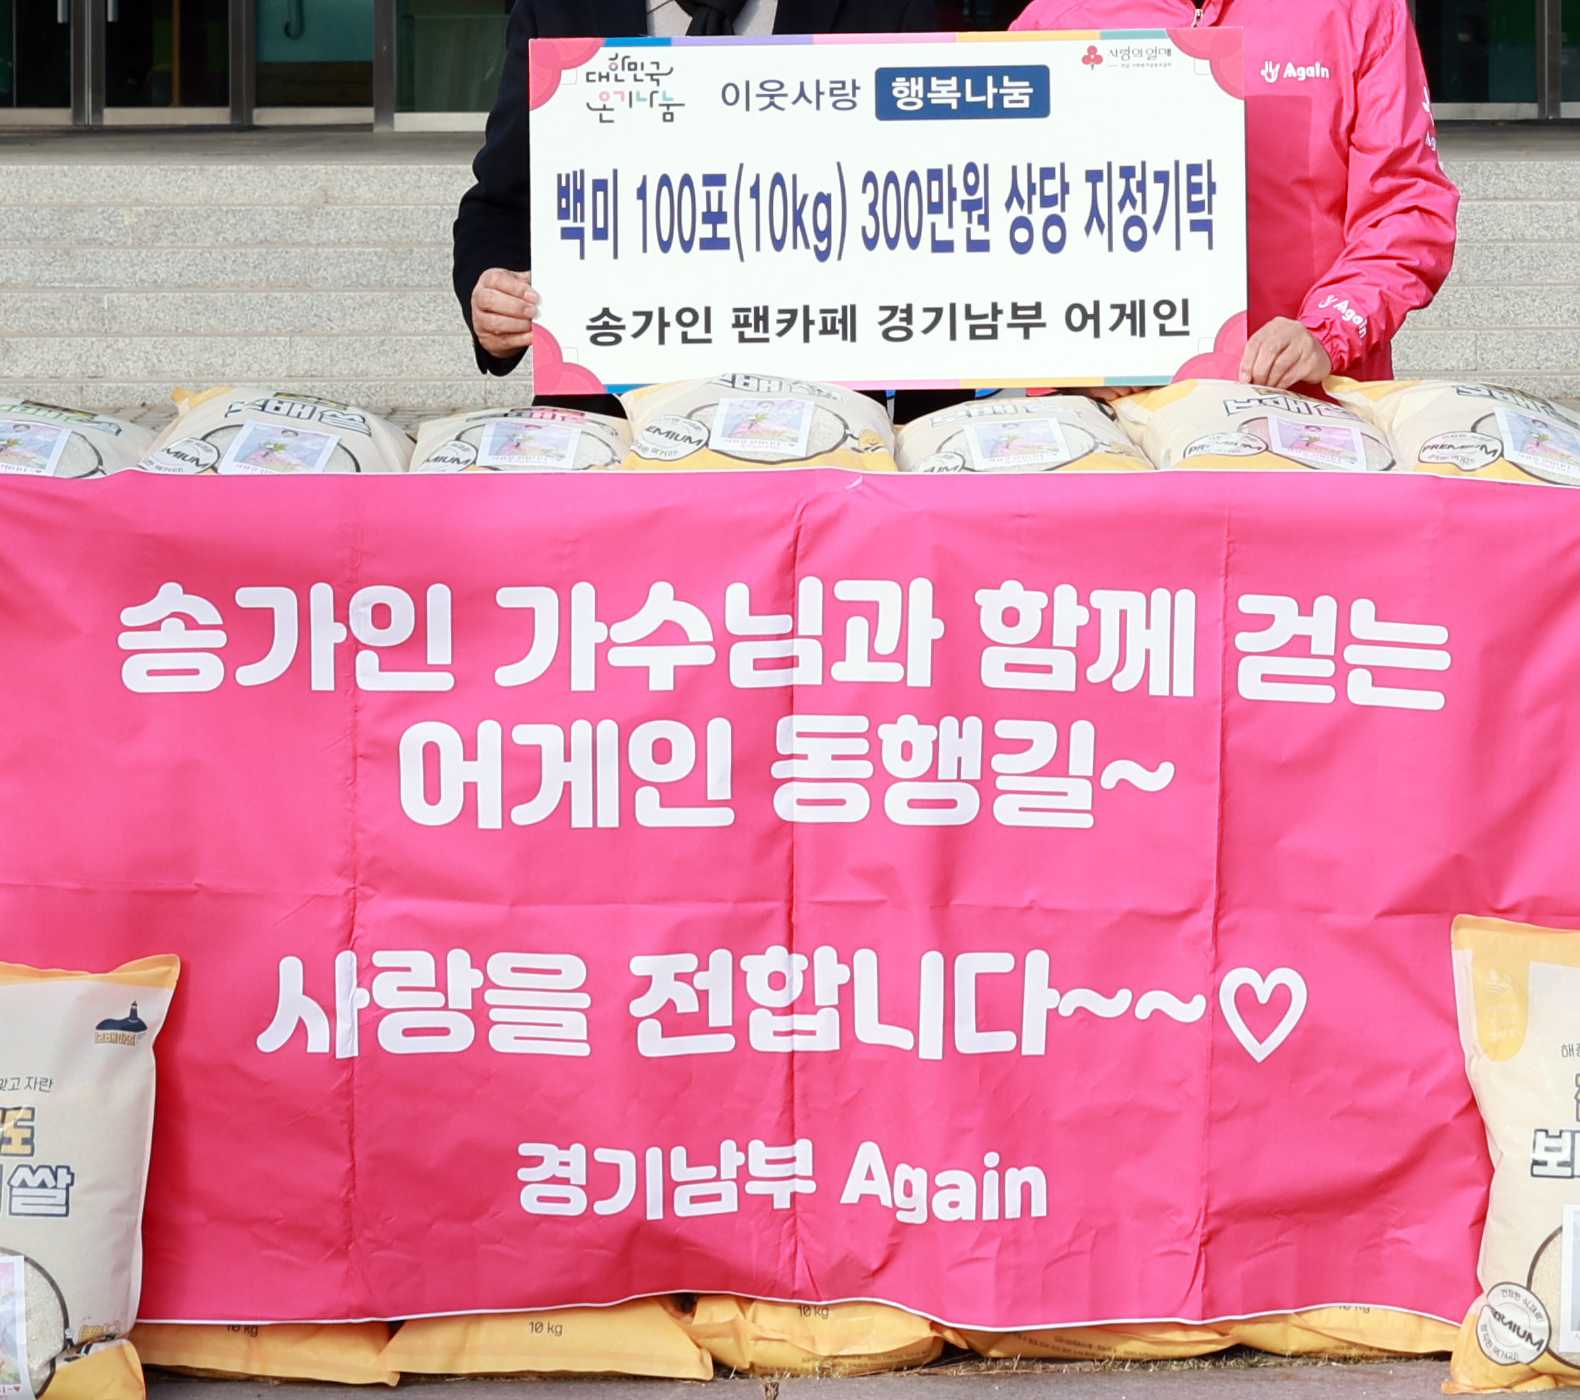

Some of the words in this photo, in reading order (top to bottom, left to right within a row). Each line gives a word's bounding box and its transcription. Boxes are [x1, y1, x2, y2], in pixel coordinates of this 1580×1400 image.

[586, 53, 673, 86] 대한민국
[1283, 62, 1329, 80] Again
[586, 91, 685, 123] 온기나눔
[721, 77, 862, 112] 이웃사랑
[890, 77, 1034, 110] 행복나눔
[556, 167, 620, 261] 백미
[635, 161, 848, 262] 100포(10kg)
[860, 163, 991, 255] 300만원
[1004, 161, 1070, 255] 상당
[1085, 158, 1218, 253] 지정기탁
[586, 306, 713, 347] 송가인
[731, 304, 857, 343] 팬카페
[877, 301, 1047, 341] 경기남부
[1063, 298, 1191, 338] 어게인
[1334, 300, 1367, 338] Again
[116, 581, 453, 693] 송가인
[494, 579, 945, 693] 가수님과
[978, 579, 1198, 700] 함께
[1235, 592, 1453, 710] 걷는
[399, 719, 734, 830] 어게인
[770, 714, 1175, 830] 동행길~
[258, 949, 593, 1058] 사랑을
[23, 1076, 53, 1093] 자란
[7, 1164, 74, 1218] 쌀
[517, 1140, 817, 1216] 경기남부
[840, 1140, 1048, 1225] Again
[529, 1321, 543, 1334] 10
[546, 1323, 562, 1337] kg
[798, 1305, 811, 1316] 10
[814, 1306, 829, 1319] kg
